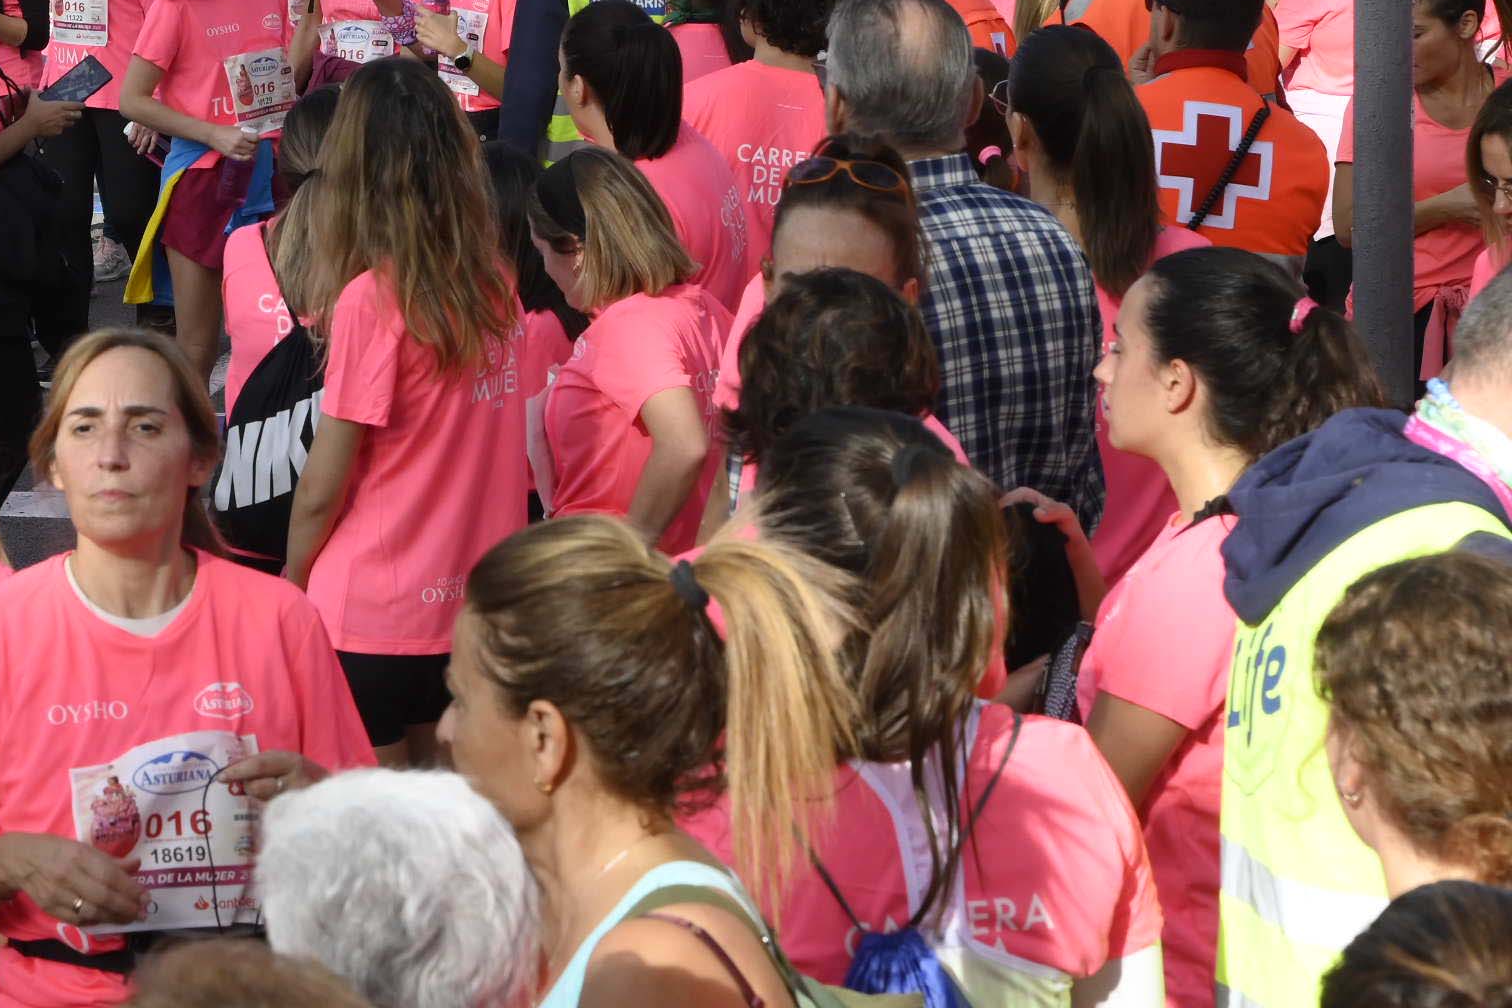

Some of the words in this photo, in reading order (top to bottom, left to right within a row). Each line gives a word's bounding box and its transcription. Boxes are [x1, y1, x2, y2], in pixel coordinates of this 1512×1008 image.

[64, 1, 85, 12] 016
[207, 23, 240, 37] OYSHO
[254, 82, 275, 95] 016
[211, 97, 234, 117] TU
[752, 166, 779, 186] DE
[48, 700, 128, 725] OYSHO
[141, 767, 213, 786] ASTURIANA
[145, 810, 213, 839] 016
[150, 846, 207, 865] 18619
[158, 873, 175, 884] DE
[177, 872, 193, 883] LA
[195, 870, 236, 882] MUJER
